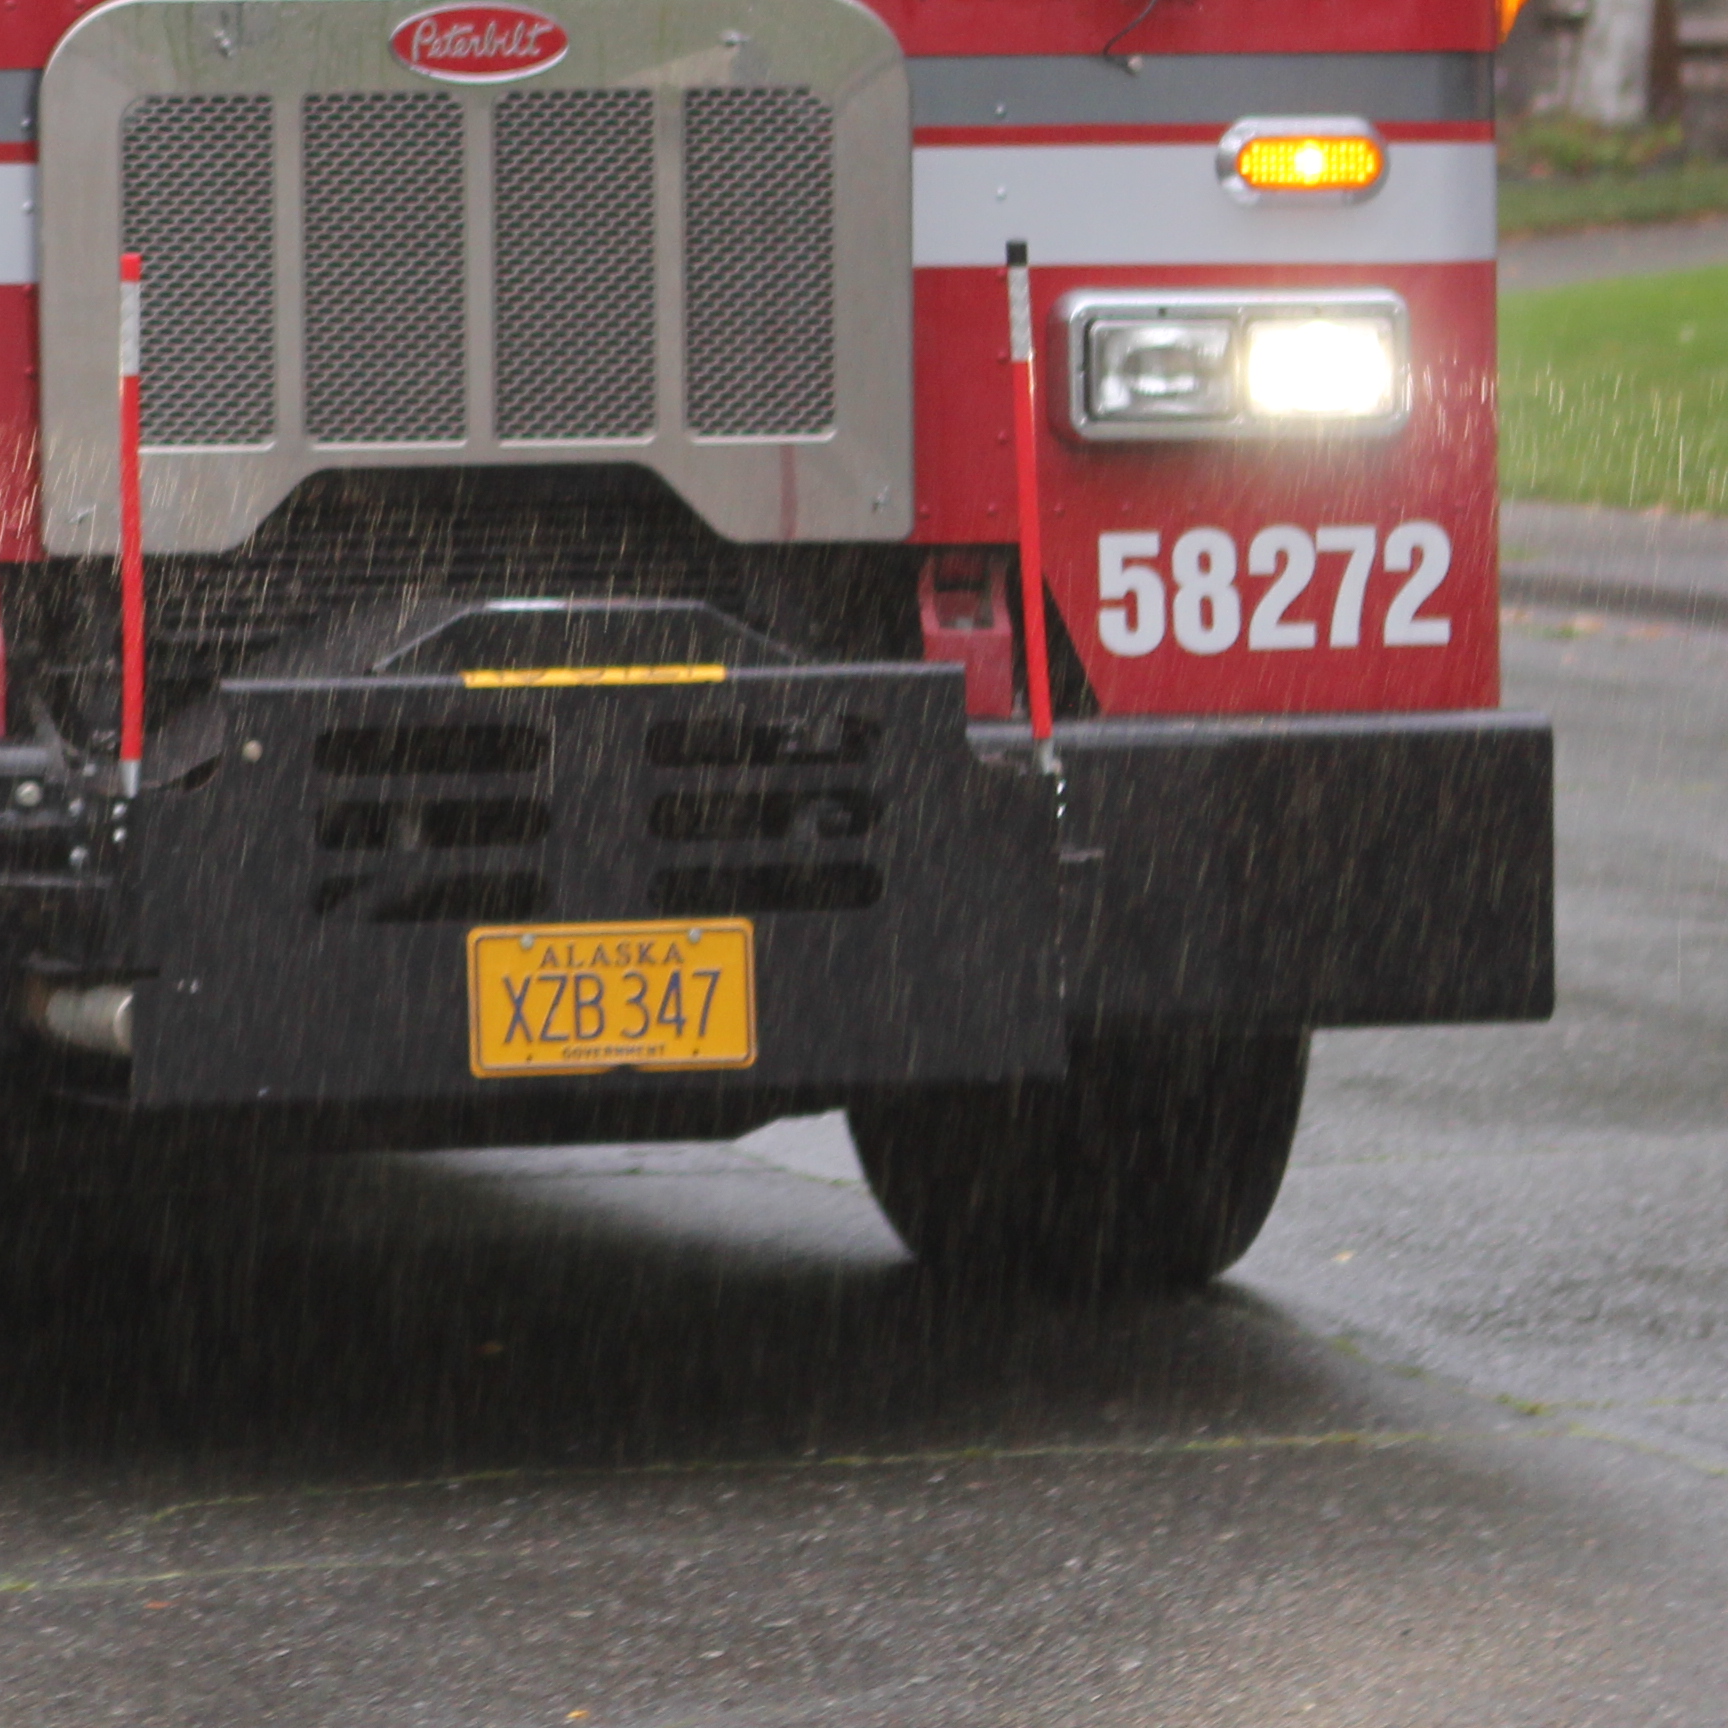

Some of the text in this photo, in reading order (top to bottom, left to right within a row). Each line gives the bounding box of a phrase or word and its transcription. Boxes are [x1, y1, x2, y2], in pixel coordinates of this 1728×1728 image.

[411, 17, 555, 63] Peterbilt
[1098, 520, 1452, 658] 58272
[538, 939, 685, 969] ALASKA
[501, 968, 723, 1044] XZB 347
